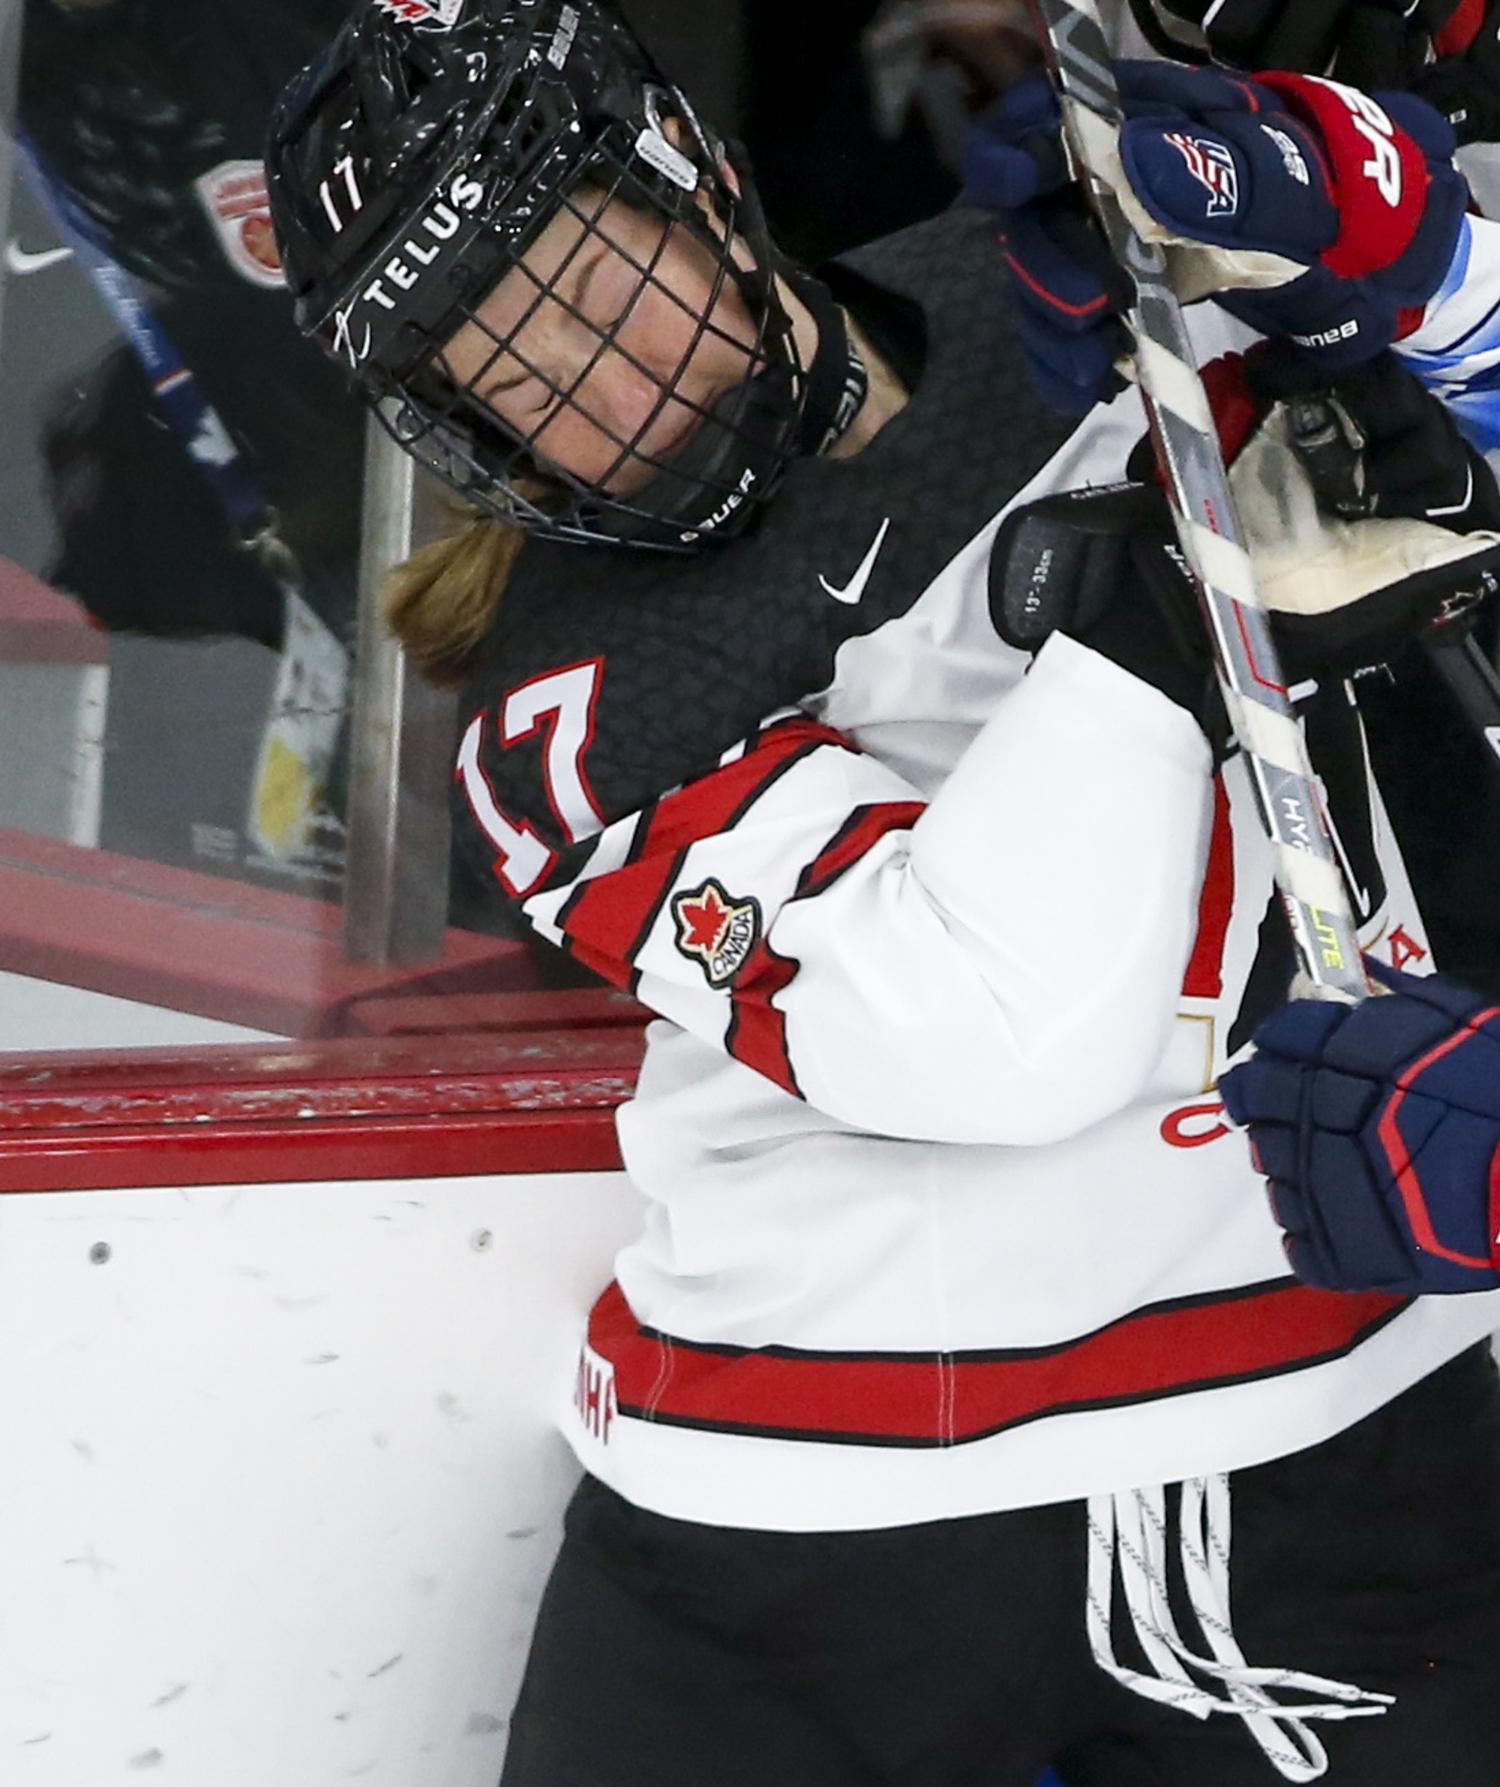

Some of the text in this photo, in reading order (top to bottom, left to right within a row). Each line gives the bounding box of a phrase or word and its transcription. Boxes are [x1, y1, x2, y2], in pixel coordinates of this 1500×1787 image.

[319, 155, 363, 233] 17
[362, 173, 484, 310] TELUS
[454, 655, 605, 897] 17
[711, 908, 753, 976] CANADA
[1308, 904, 1345, 970] LITE
